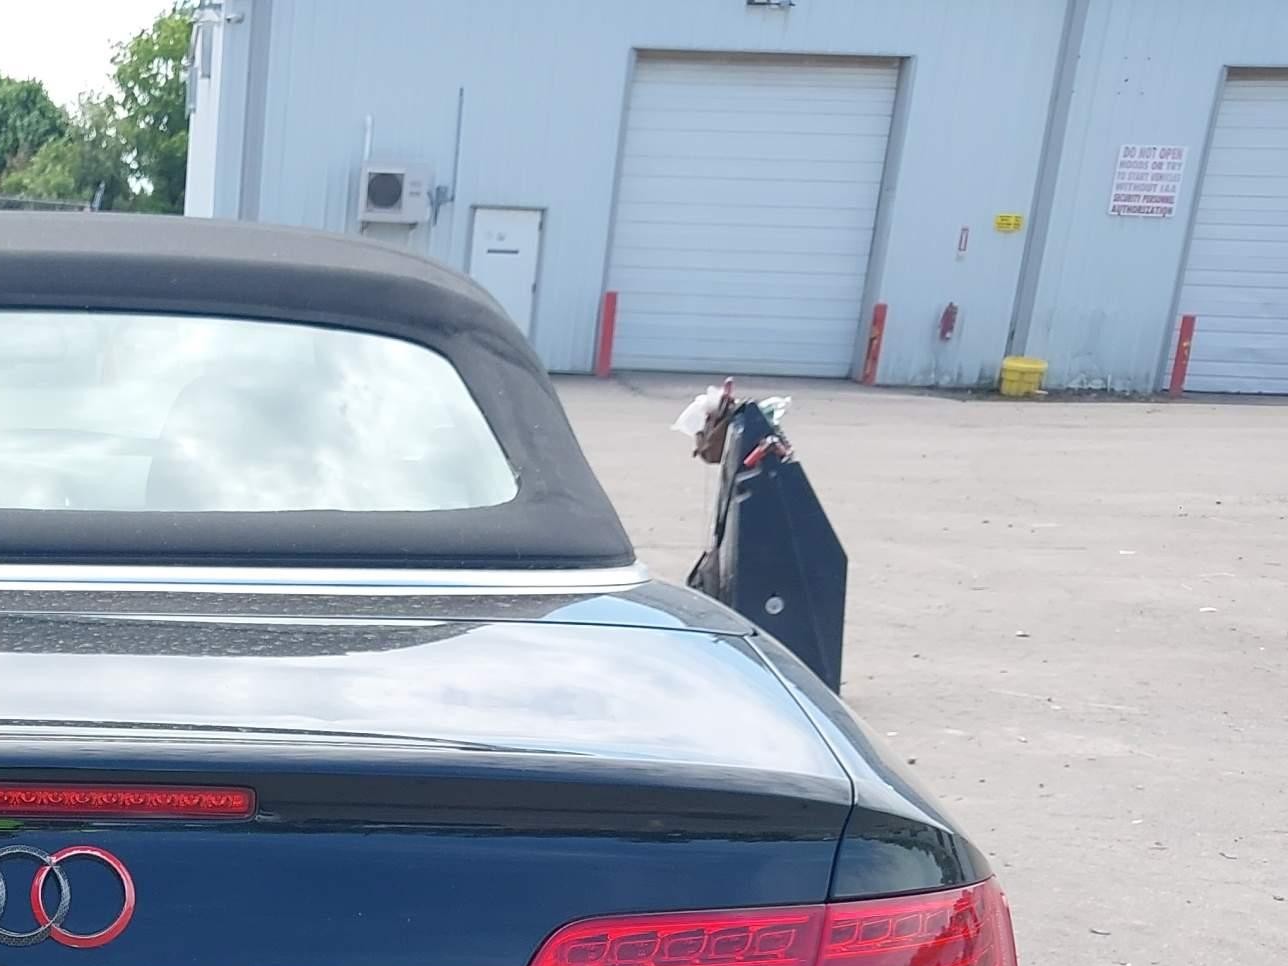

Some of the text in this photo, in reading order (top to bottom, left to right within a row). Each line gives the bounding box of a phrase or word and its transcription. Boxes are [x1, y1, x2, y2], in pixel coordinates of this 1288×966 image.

[1122, 146, 1184, 160] DO NOT OPEN
[1113, 193, 1141, 203] SECURITY
[1111, 204, 1173, 215] AUTHORIZATION
